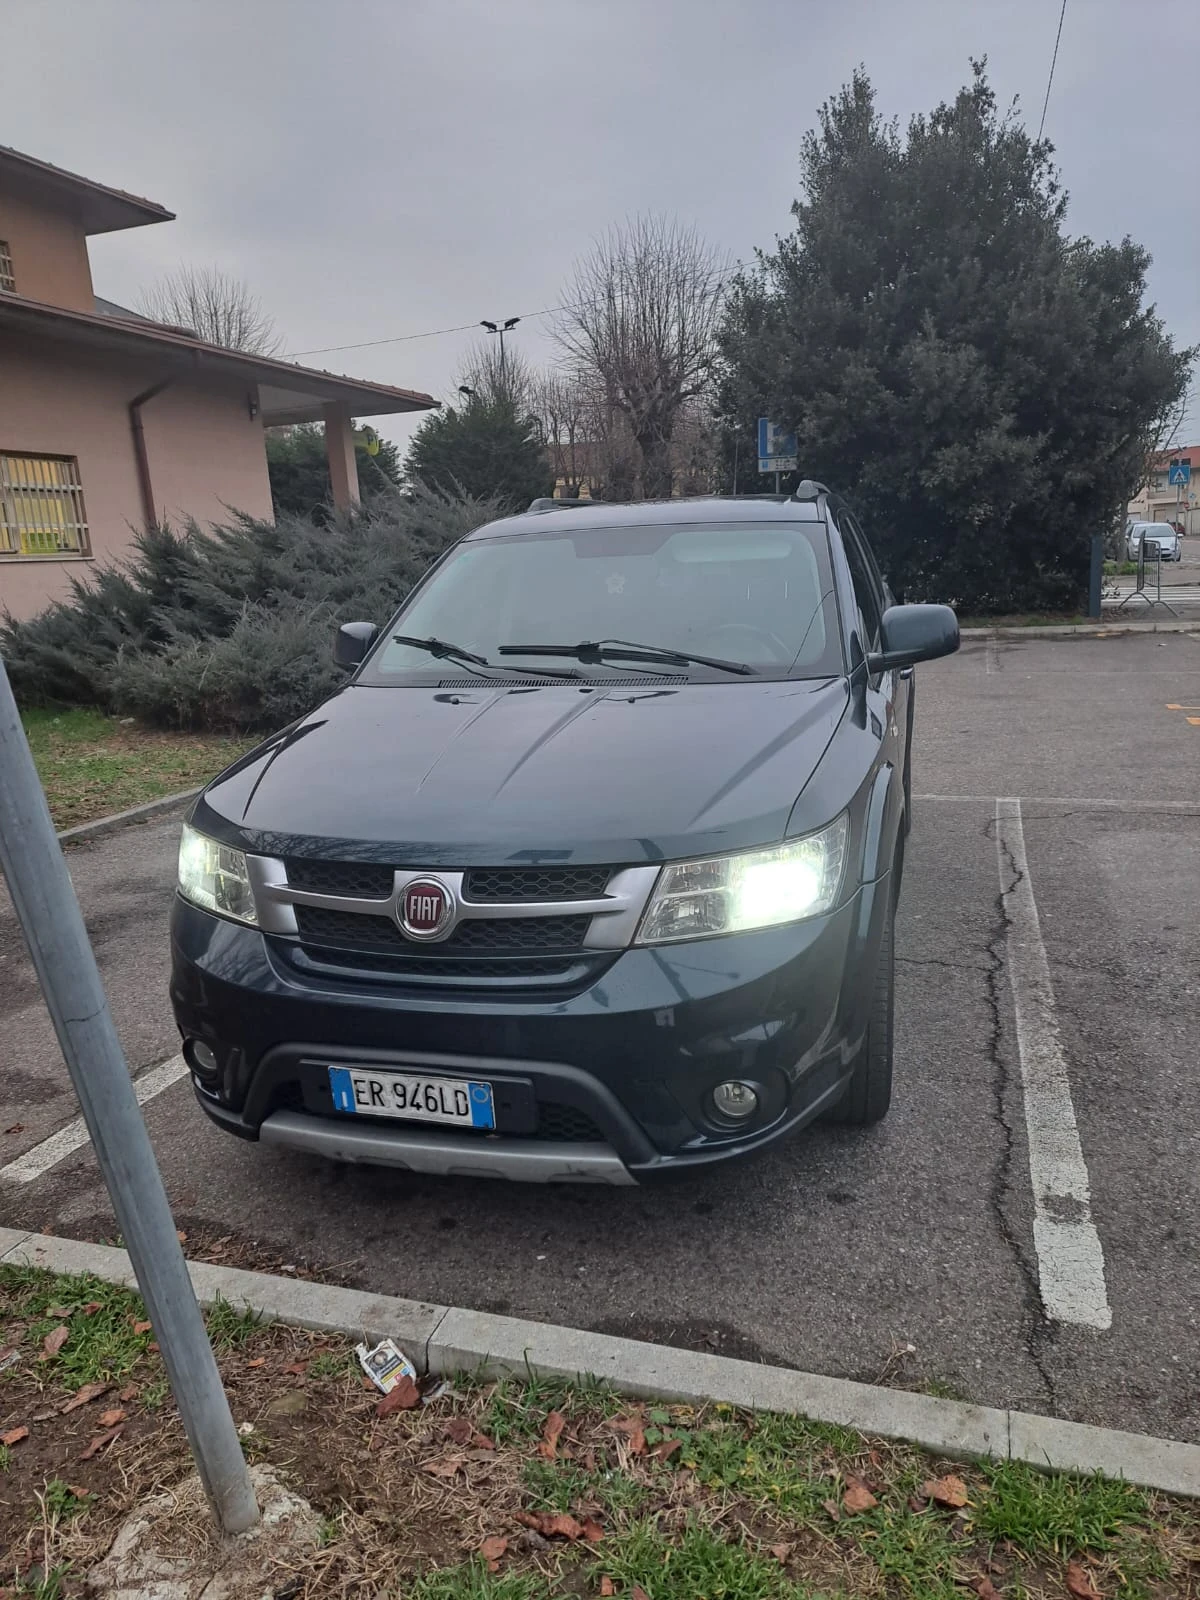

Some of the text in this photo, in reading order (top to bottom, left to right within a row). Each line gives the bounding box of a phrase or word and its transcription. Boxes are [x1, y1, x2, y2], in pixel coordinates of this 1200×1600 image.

[410, 895, 440, 921] FIAT
[353, 1079, 385, 1107] ER
[392, 1082, 470, 1117] 946LD
